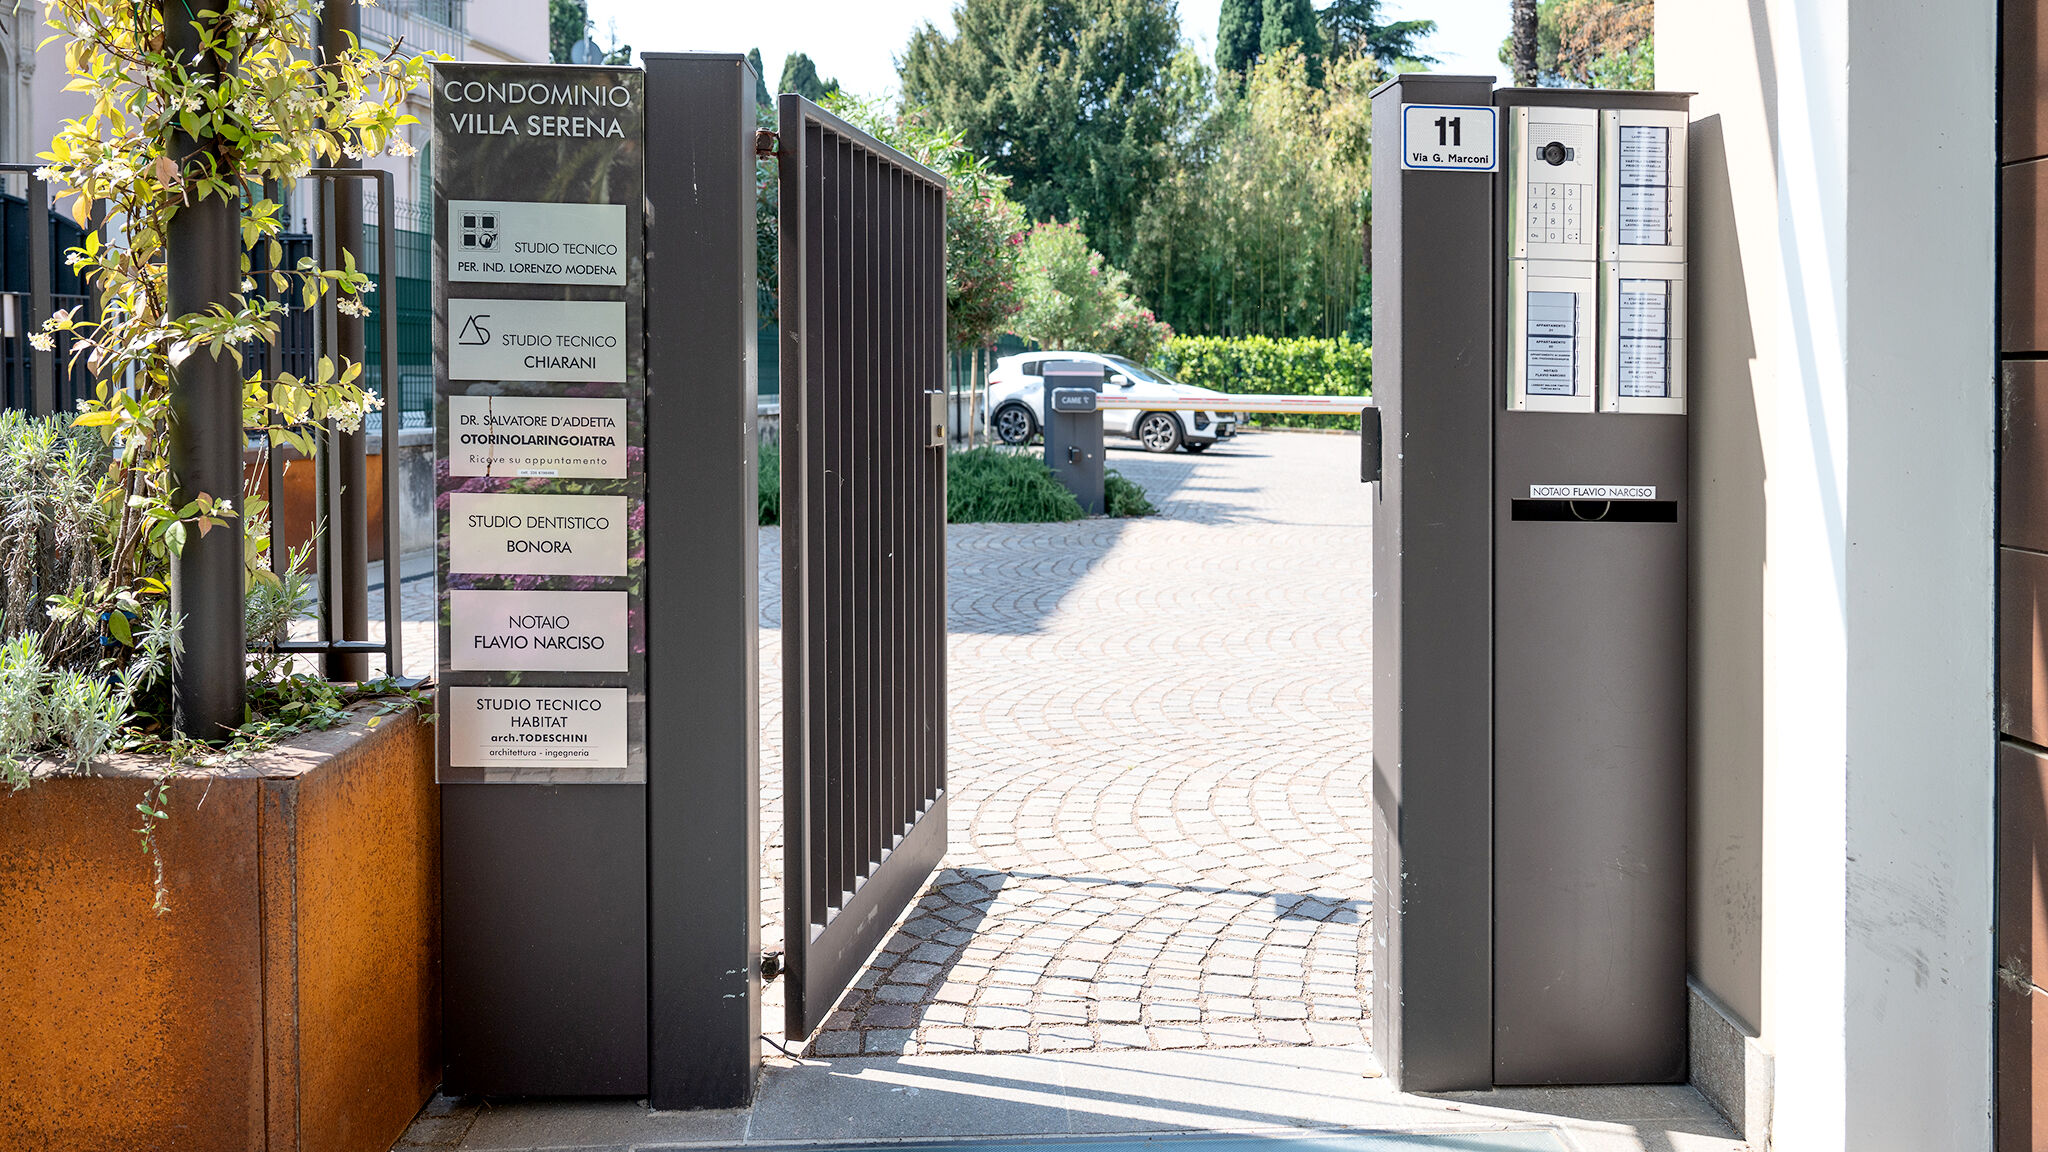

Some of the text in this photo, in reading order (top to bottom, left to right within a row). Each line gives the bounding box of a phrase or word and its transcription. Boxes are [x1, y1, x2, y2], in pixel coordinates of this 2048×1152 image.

[444, 80, 631, 107] CONDOMINIO
[450, 113, 625, 139] VILLA SERENA
[1434, 116, 1461, 146] 11
[1413, 153, 1489, 164] Via G. Marconi
[1550, 187, 1556, 196] 2
[1568, 188, 1573, 197] 3
[1551, 202, 1556, 210] 5
[1568, 203, 1573, 211] 6
[1532, 216, 1538, 225] 7
[1550, 217, 1556, 225] 8
[514, 241, 618, 256] STUDIO TECNICO
[458, 262, 617, 276] PER. IND. LORENZO MODENA
[502, 334, 617, 348] STUDIO TECNICO
[524, 355, 596, 369] CHIARANI
[1061, 396, 1082, 404] CAME
[460, 415, 616, 428] DR. SALVATORE D'ADDETTA
[460, 434, 616, 447] OTORINOLARINGOIATRA
[509, 456, 521, 464] su
[525, 455, 608, 466] appuntamento
[1533, 487, 1652, 498] NOTAIO FLAVIO NARCISO
[468, 515, 610, 530] STUDIO DENTISTICO
[507, 540, 572, 553] BONORA
[509, 615, 570, 629] NOTAIO
[474, 635, 605, 650] FLAVIO NARCISO
[476, 698, 602, 711] STUDIO TECNICO
[511, 716, 568, 728] HABITAT
[491, 733, 588, 743] arch.TODESCHINI
[489, 748, 537, 757] architettura
[545, 749, 589, 758] ingegneria
